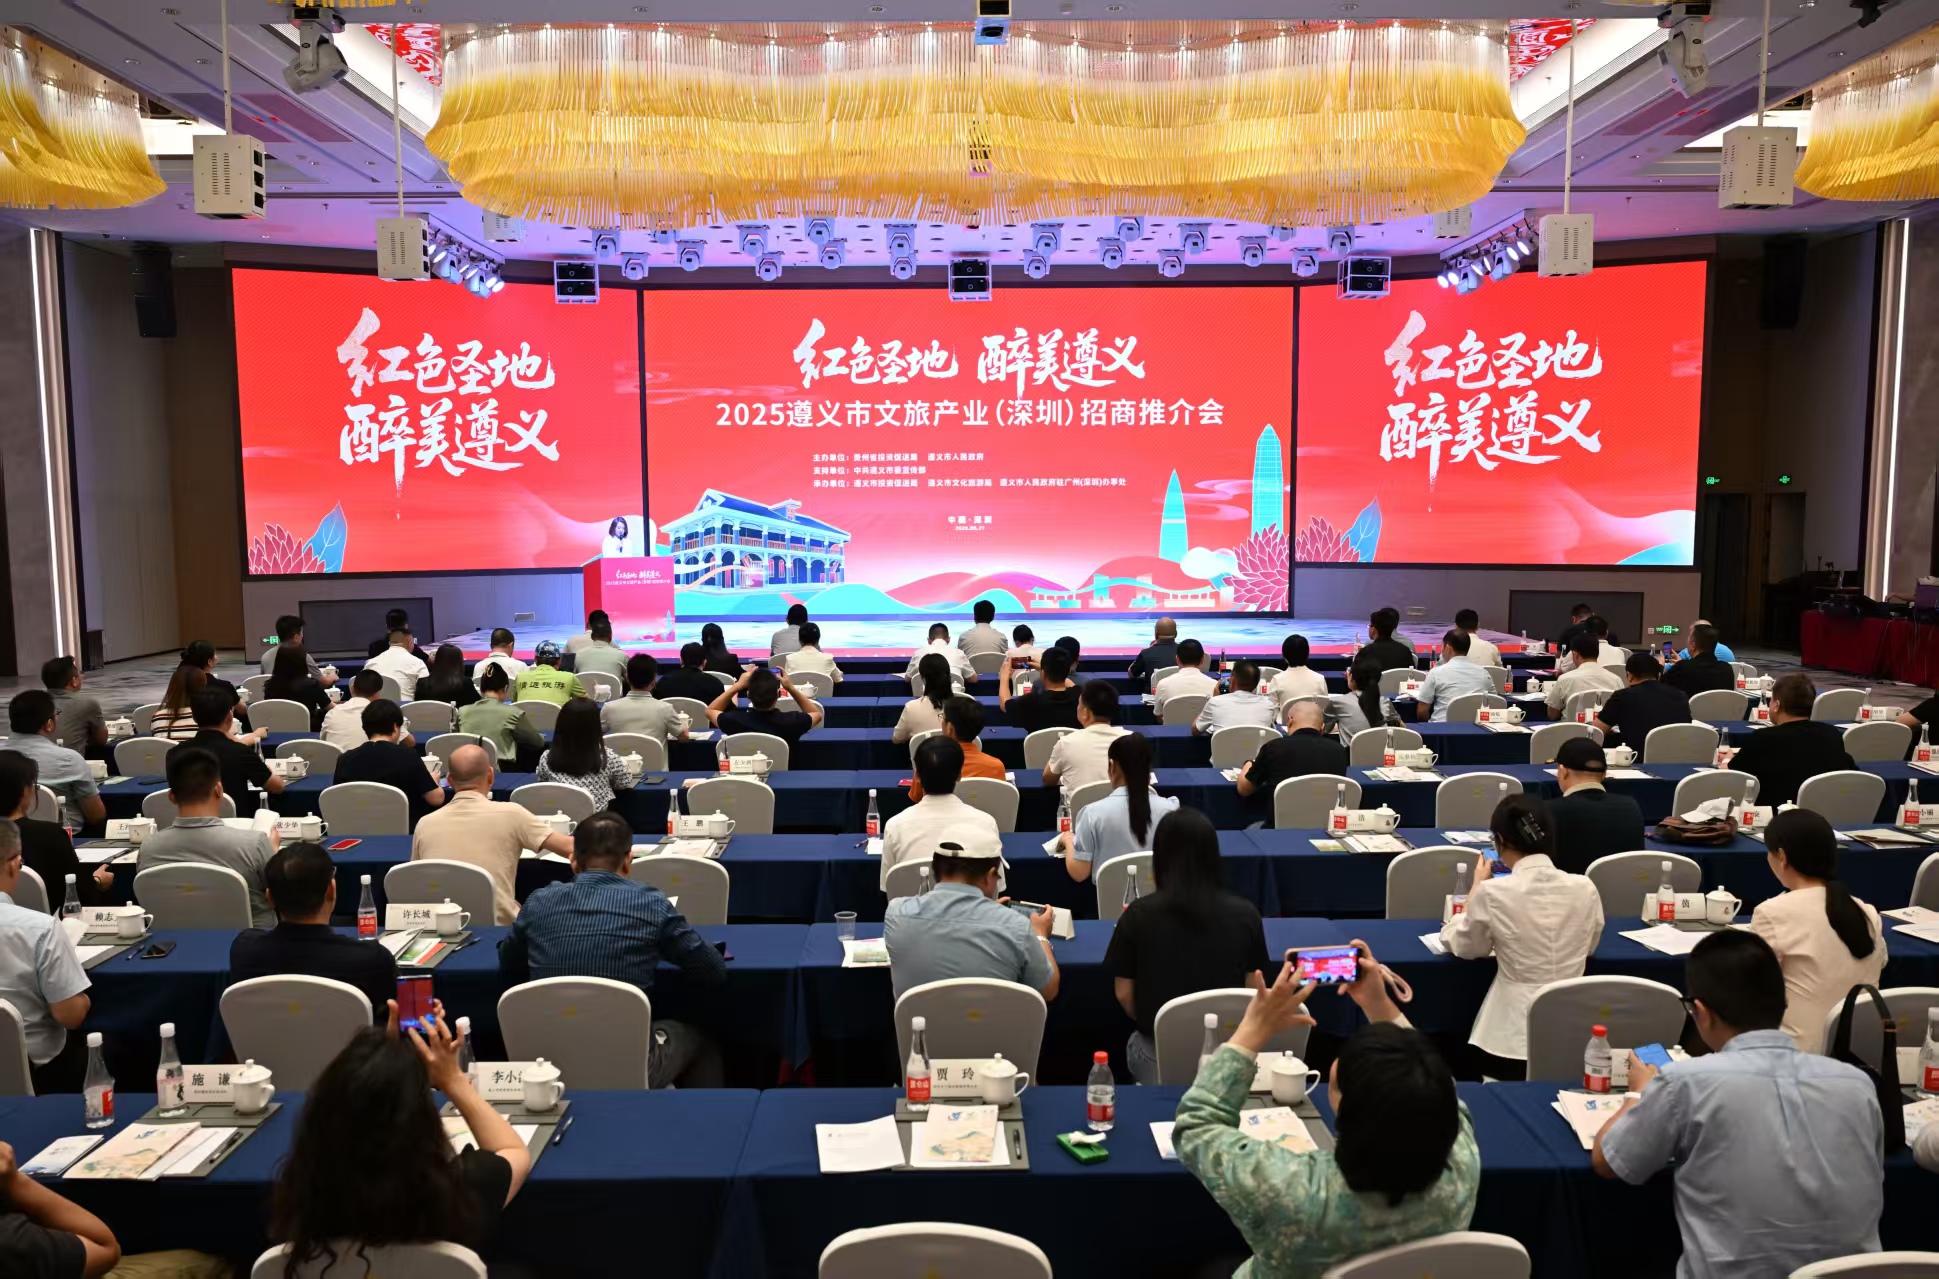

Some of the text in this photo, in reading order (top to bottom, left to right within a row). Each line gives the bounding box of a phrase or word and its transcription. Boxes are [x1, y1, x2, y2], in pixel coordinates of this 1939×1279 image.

[337, 307, 556, 397] 红色圣地
[793, 318, 1146, 398] 红色圣地 醉美遵义
[1384, 310, 1603, 396] 红色圣地
[339, 395, 560, 484] 醉美遵义
[1379, 392, 1602, 488] 醉美遵义
